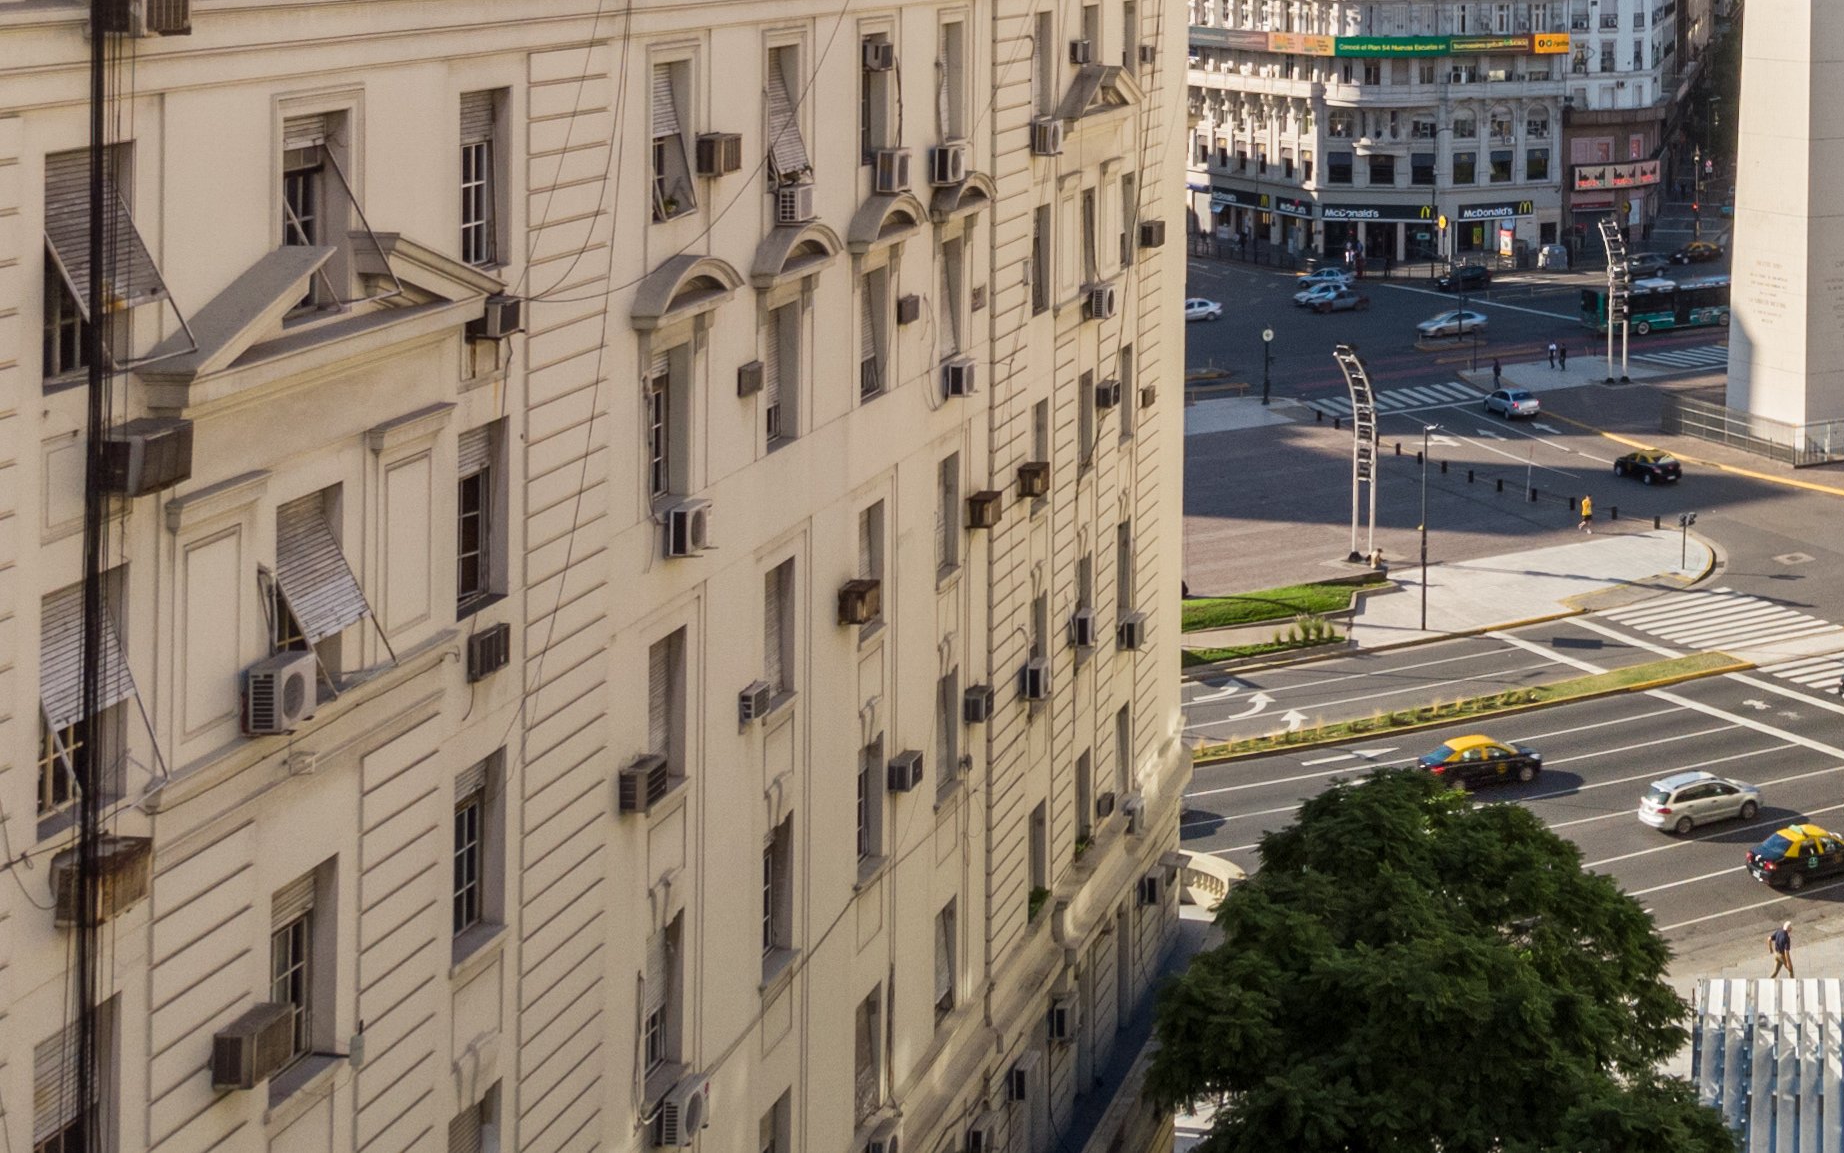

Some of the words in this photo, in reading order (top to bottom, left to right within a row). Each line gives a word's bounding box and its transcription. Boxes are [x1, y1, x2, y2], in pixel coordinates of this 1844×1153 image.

[1391, 43, 1414, 51] Nuevas
[1414, 43, 1438, 51] Escuelas
[1324, 208, 1379, 218] McDonald's
[1463, 207, 1513, 218] McDonald's
